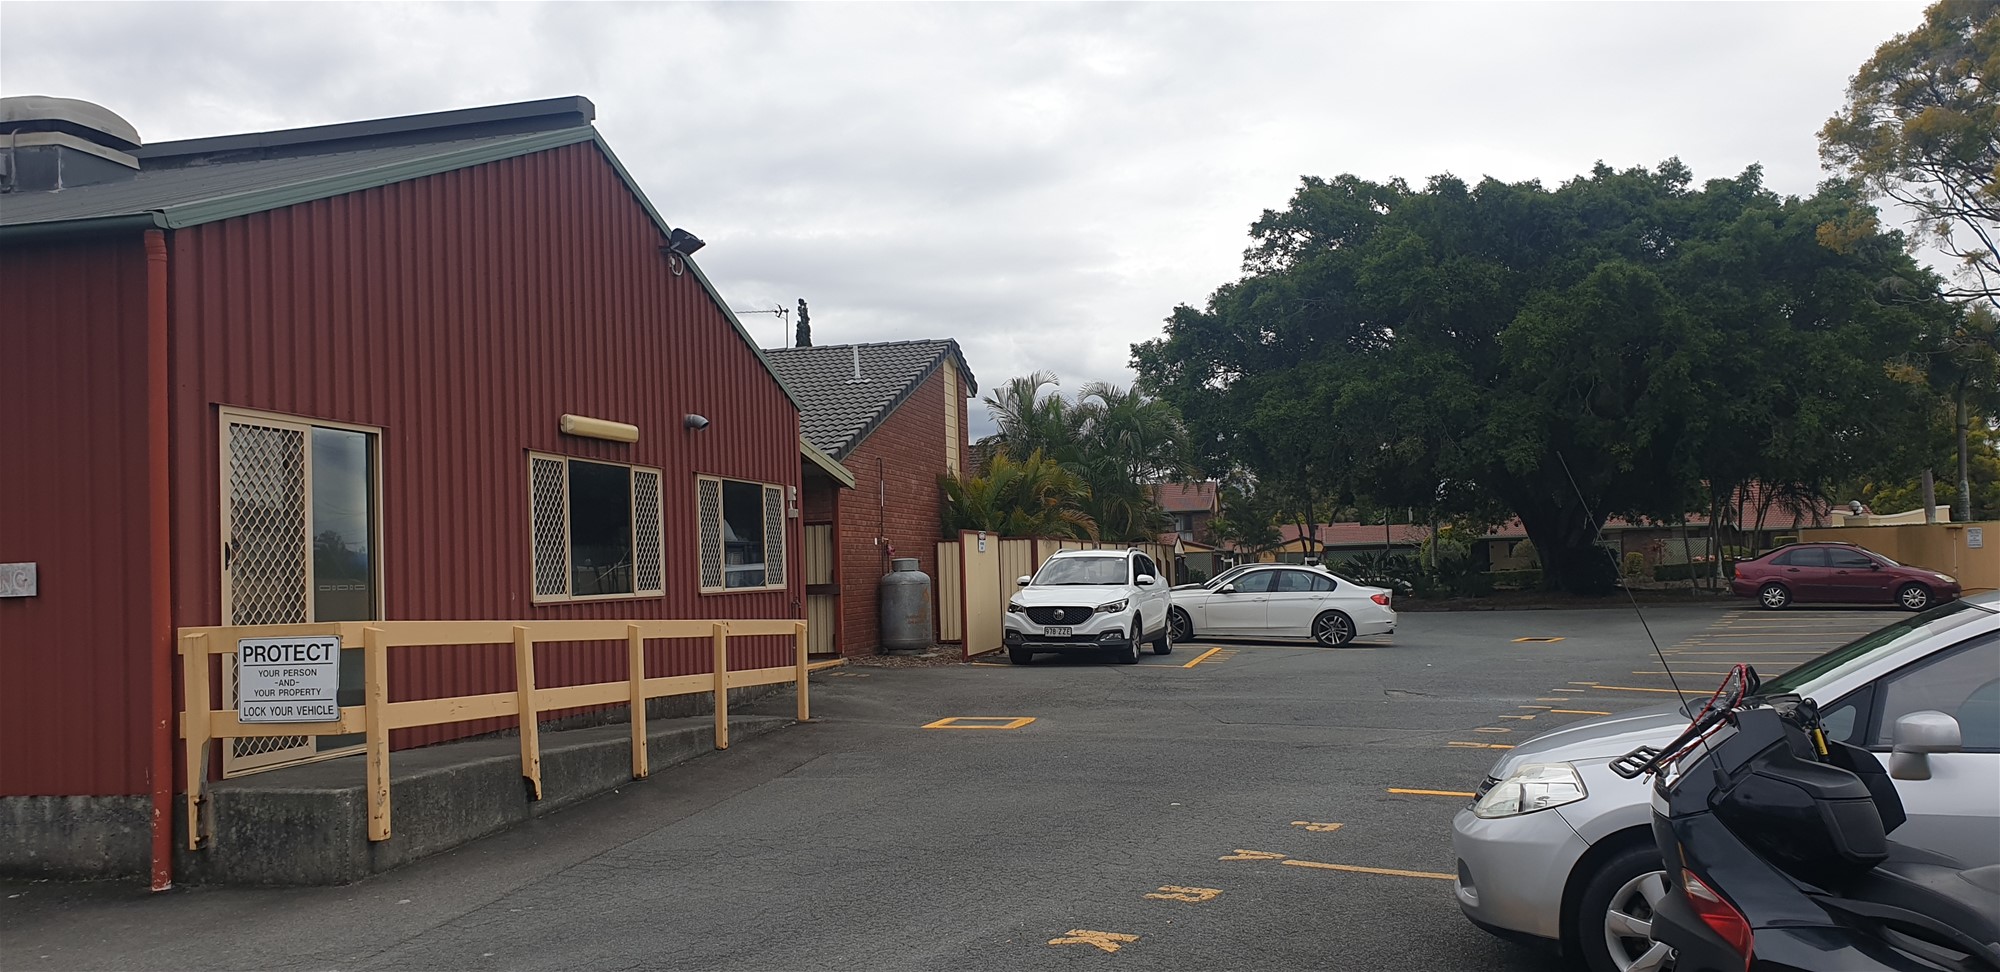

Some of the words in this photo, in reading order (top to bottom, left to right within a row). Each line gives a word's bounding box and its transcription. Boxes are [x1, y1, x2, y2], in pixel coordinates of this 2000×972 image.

[243, 643, 334, 663] PROTECT
[258, 669, 280, 678] YOUR
[283, 668, 317, 677] PERSON
[254, 689, 275, 697] YOUR
[278, 688, 321, 696] PROPERTY
[243, 706, 266, 717] LOCK
[270, 706, 293, 716] YOUR
[296, 705, 334, 716] VEHICLE
